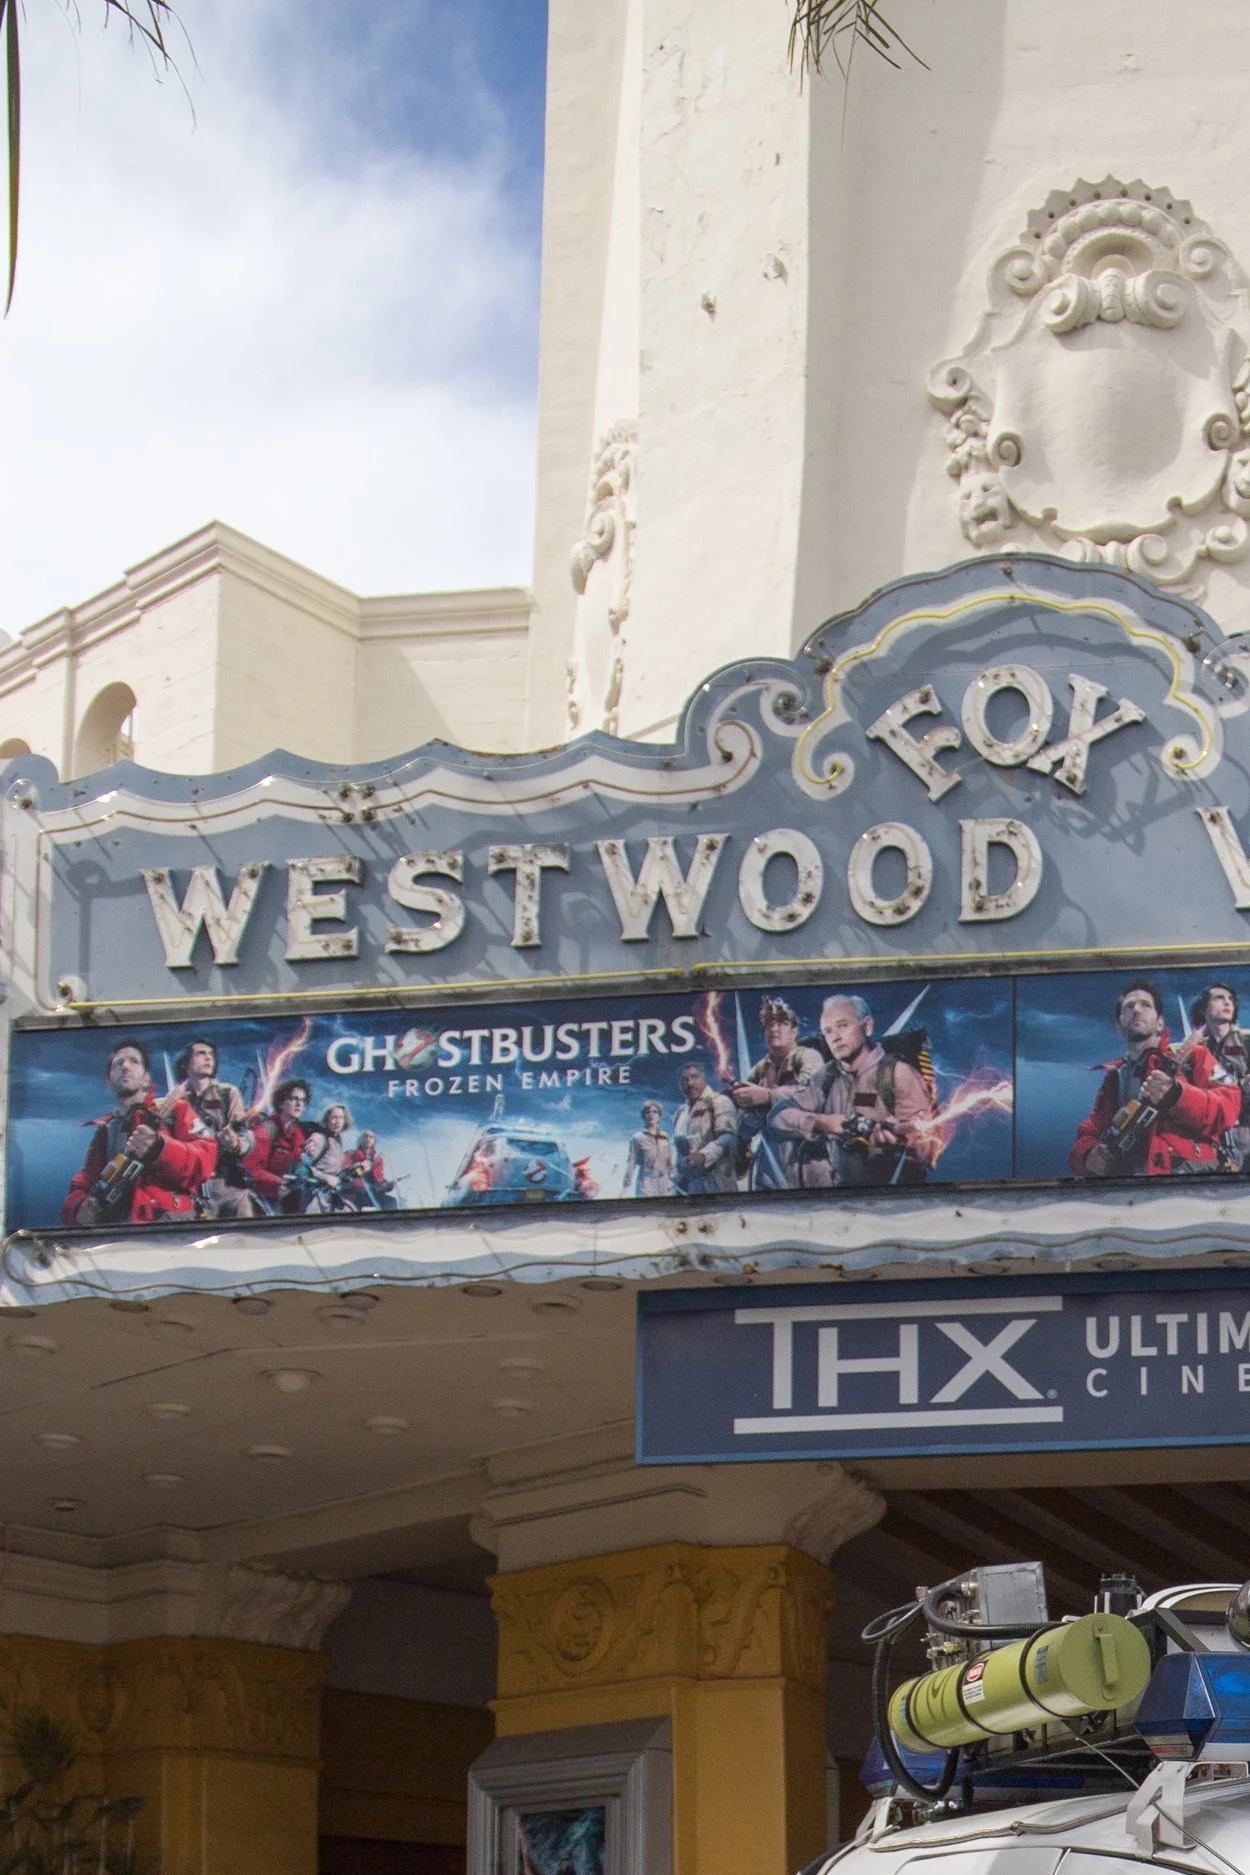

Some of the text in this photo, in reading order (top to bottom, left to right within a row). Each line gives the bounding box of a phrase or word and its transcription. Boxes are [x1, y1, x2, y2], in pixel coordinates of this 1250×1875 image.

[865, 663, 1146, 802] FOX
[139, 817, 1043, 968] WESTWOOD
[388, 1066, 632, 1098] FROZEN EMPIRE
